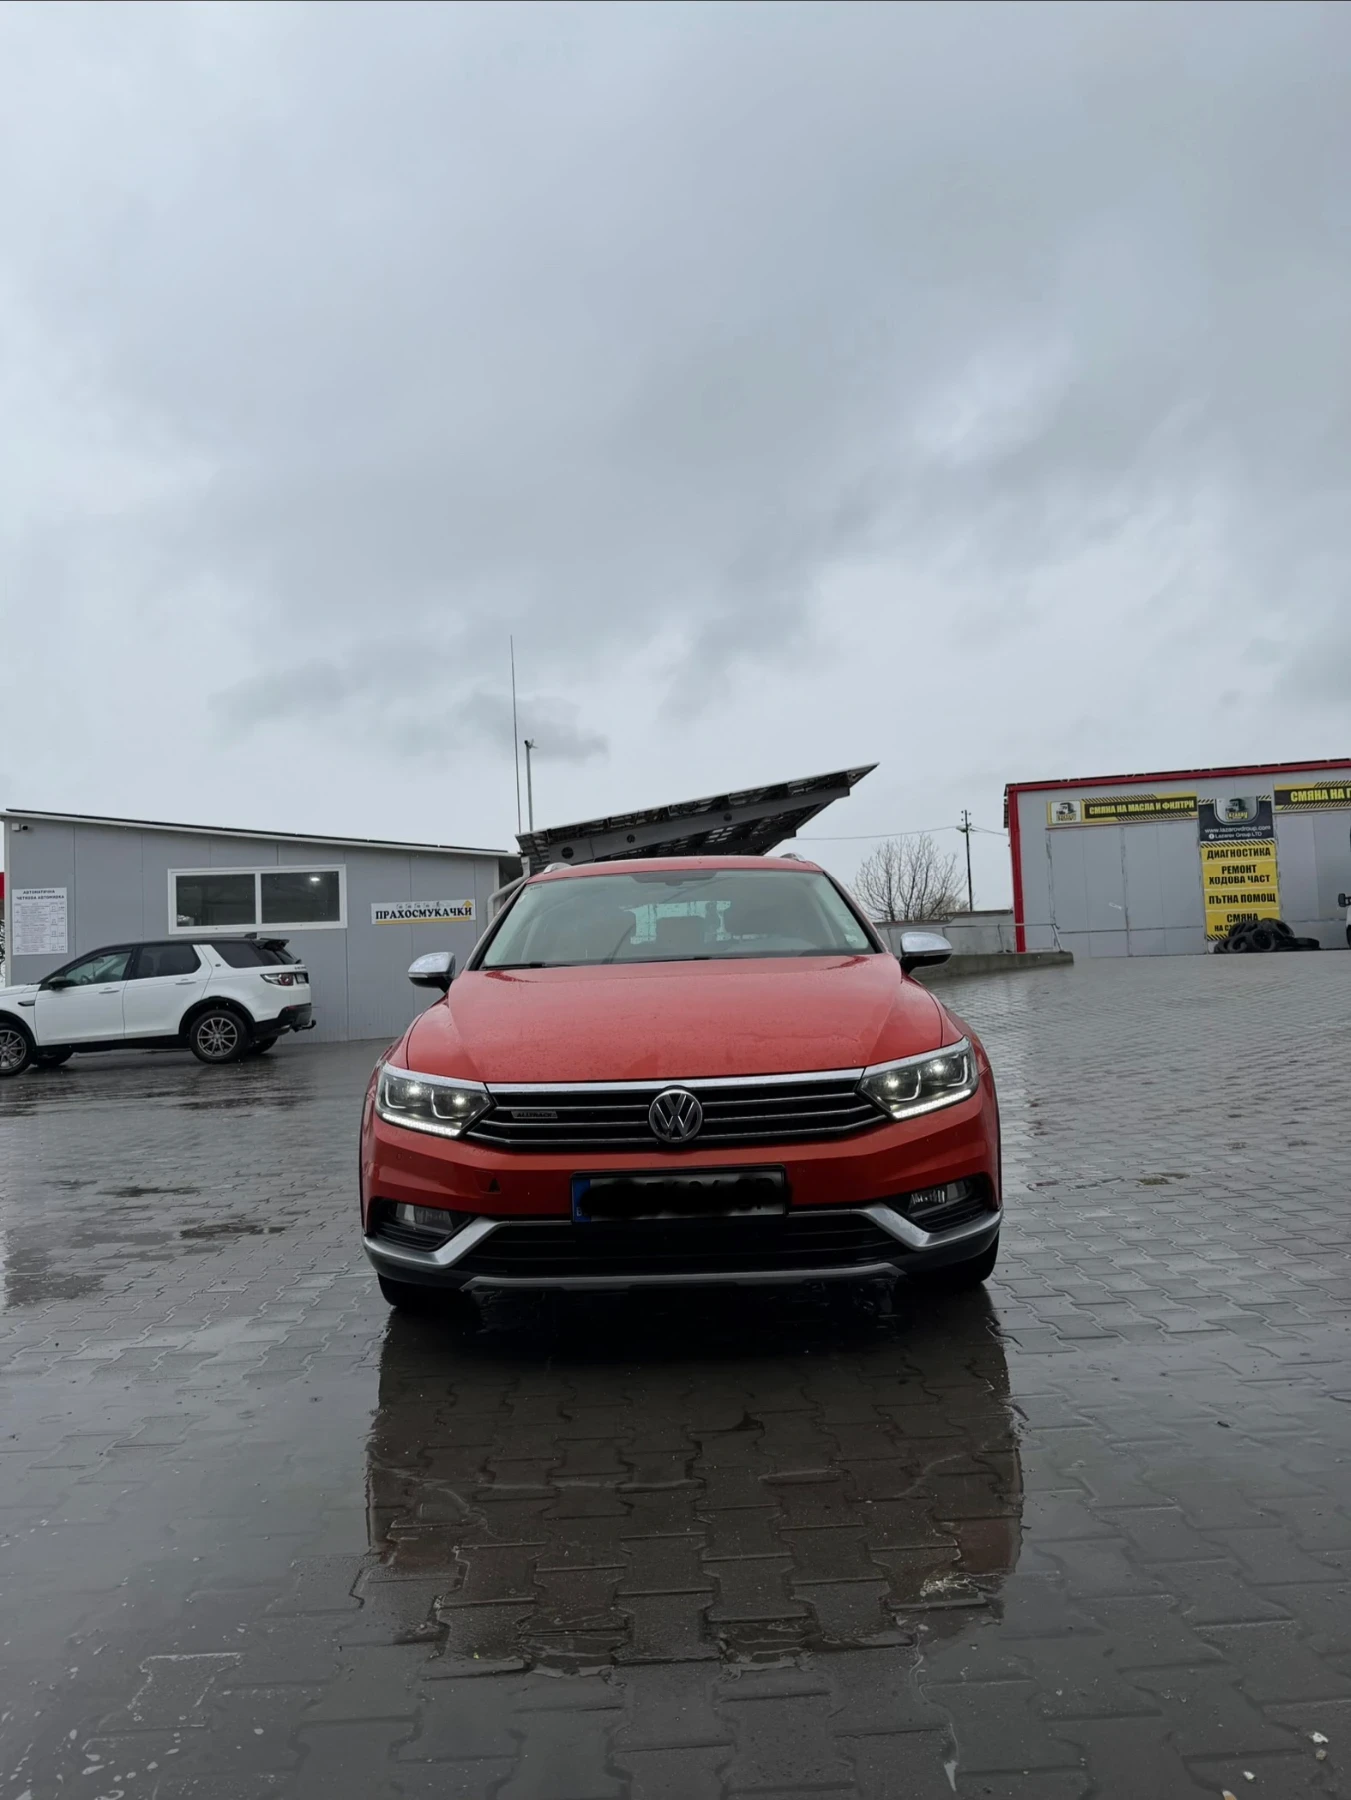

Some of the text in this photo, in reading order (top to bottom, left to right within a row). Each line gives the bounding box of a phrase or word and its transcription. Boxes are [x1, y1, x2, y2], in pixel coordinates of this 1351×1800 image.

[1290, 790, 1329, 802] СМЯНА
[1330, 788, 1345, 800] НА
[1089, 800, 1195, 815] СМЯНА НА МАСЛА И ФИЛТРИ
[1235, 831, 1251, 839] Group
[1206, 847, 1271, 860] ДИАГНОСТИКА
[1221, 864, 1257, 875] РЕМОНТ
[1209, 874, 1270, 886] ХОДОВА ЧАСТ
[1208, 893, 1276, 904] ПЪТНА ПОМОЩ
[375, 907, 473, 920] ПРАХОСМУКАЧКИ
[1226, 913, 1258, 923] СМЯНА
